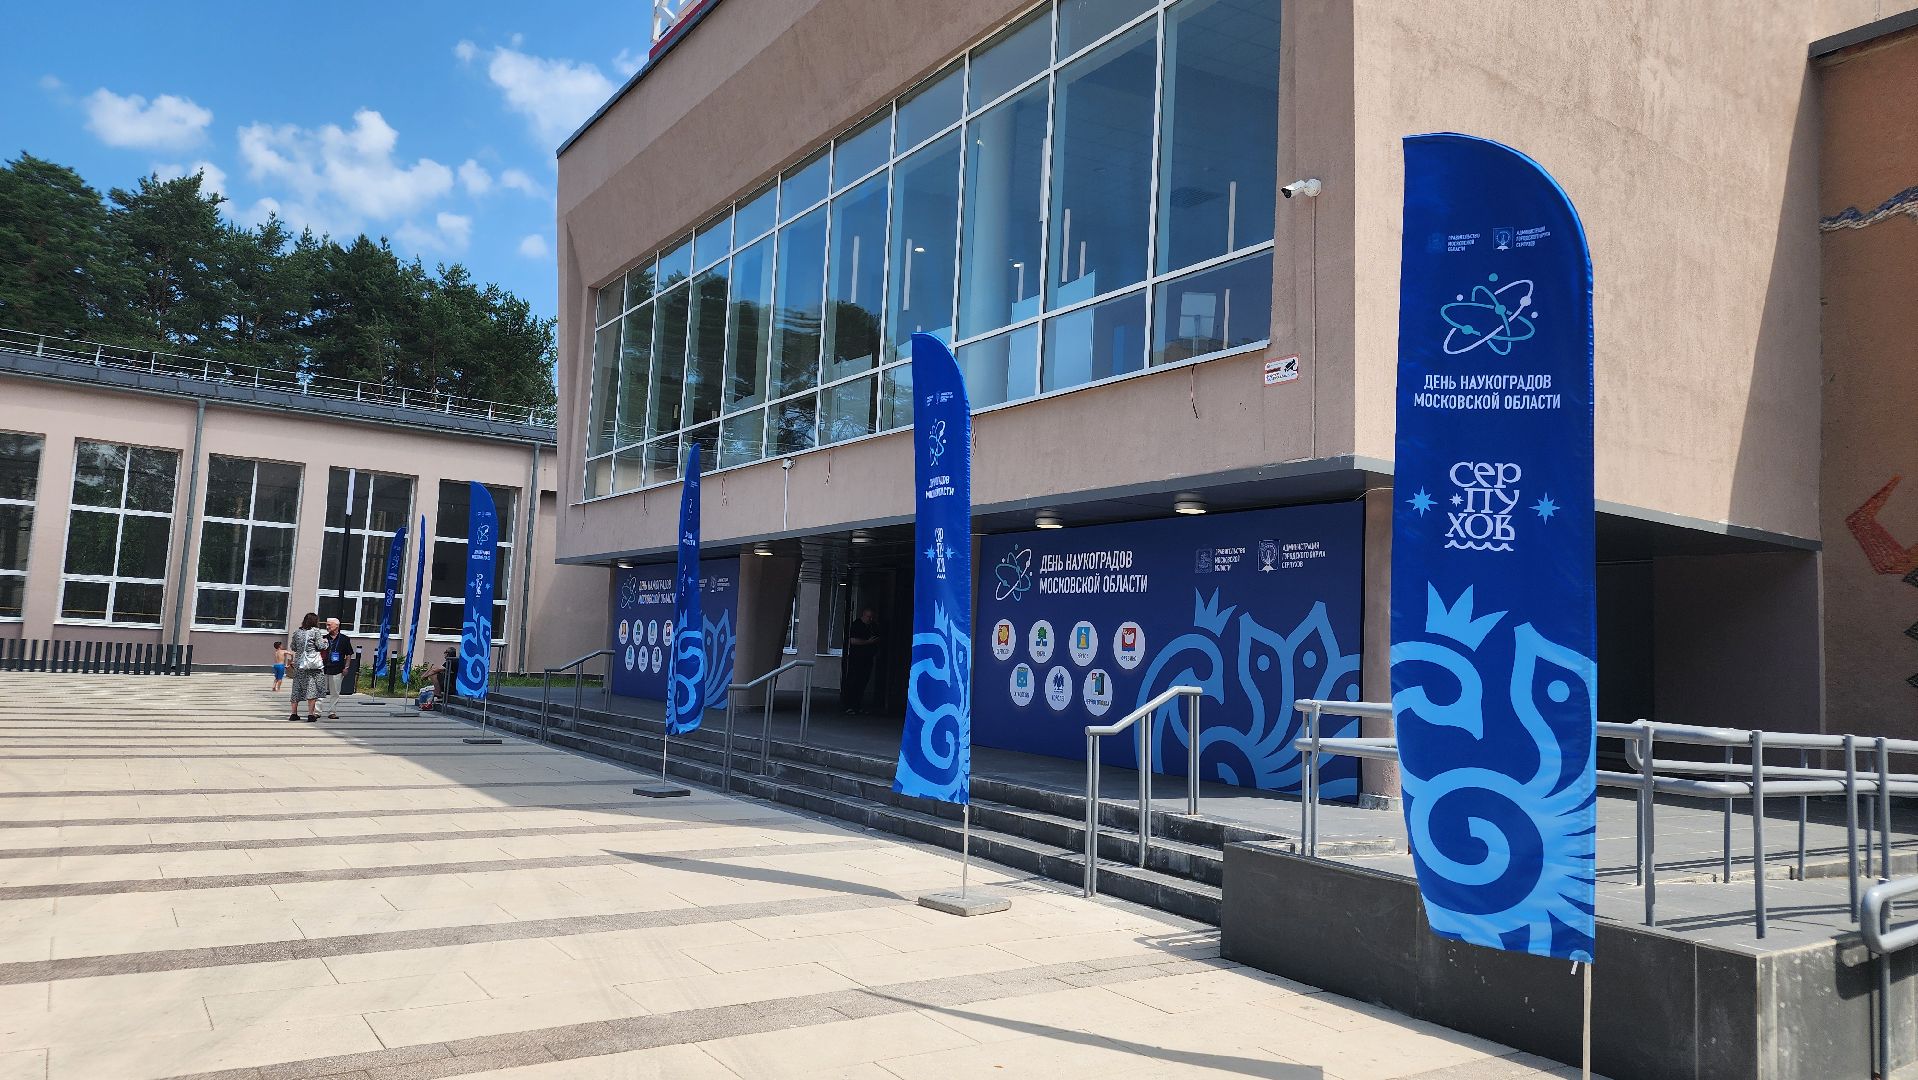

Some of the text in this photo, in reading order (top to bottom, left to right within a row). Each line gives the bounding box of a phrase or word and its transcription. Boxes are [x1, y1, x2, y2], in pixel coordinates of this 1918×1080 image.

[1424, 374, 1552, 391] ДЕНЬ НАУКОГРАДОВ
[1413, 392, 1561, 410] МОСКОВСКОЙ ОБЛАСТИ
[1040, 550, 1133, 574] ДЕНЬ НАУКОГРАДОВ
[1040, 572, 1148, 594] МОСКОВСКОЙ ОБЛАСТИ
